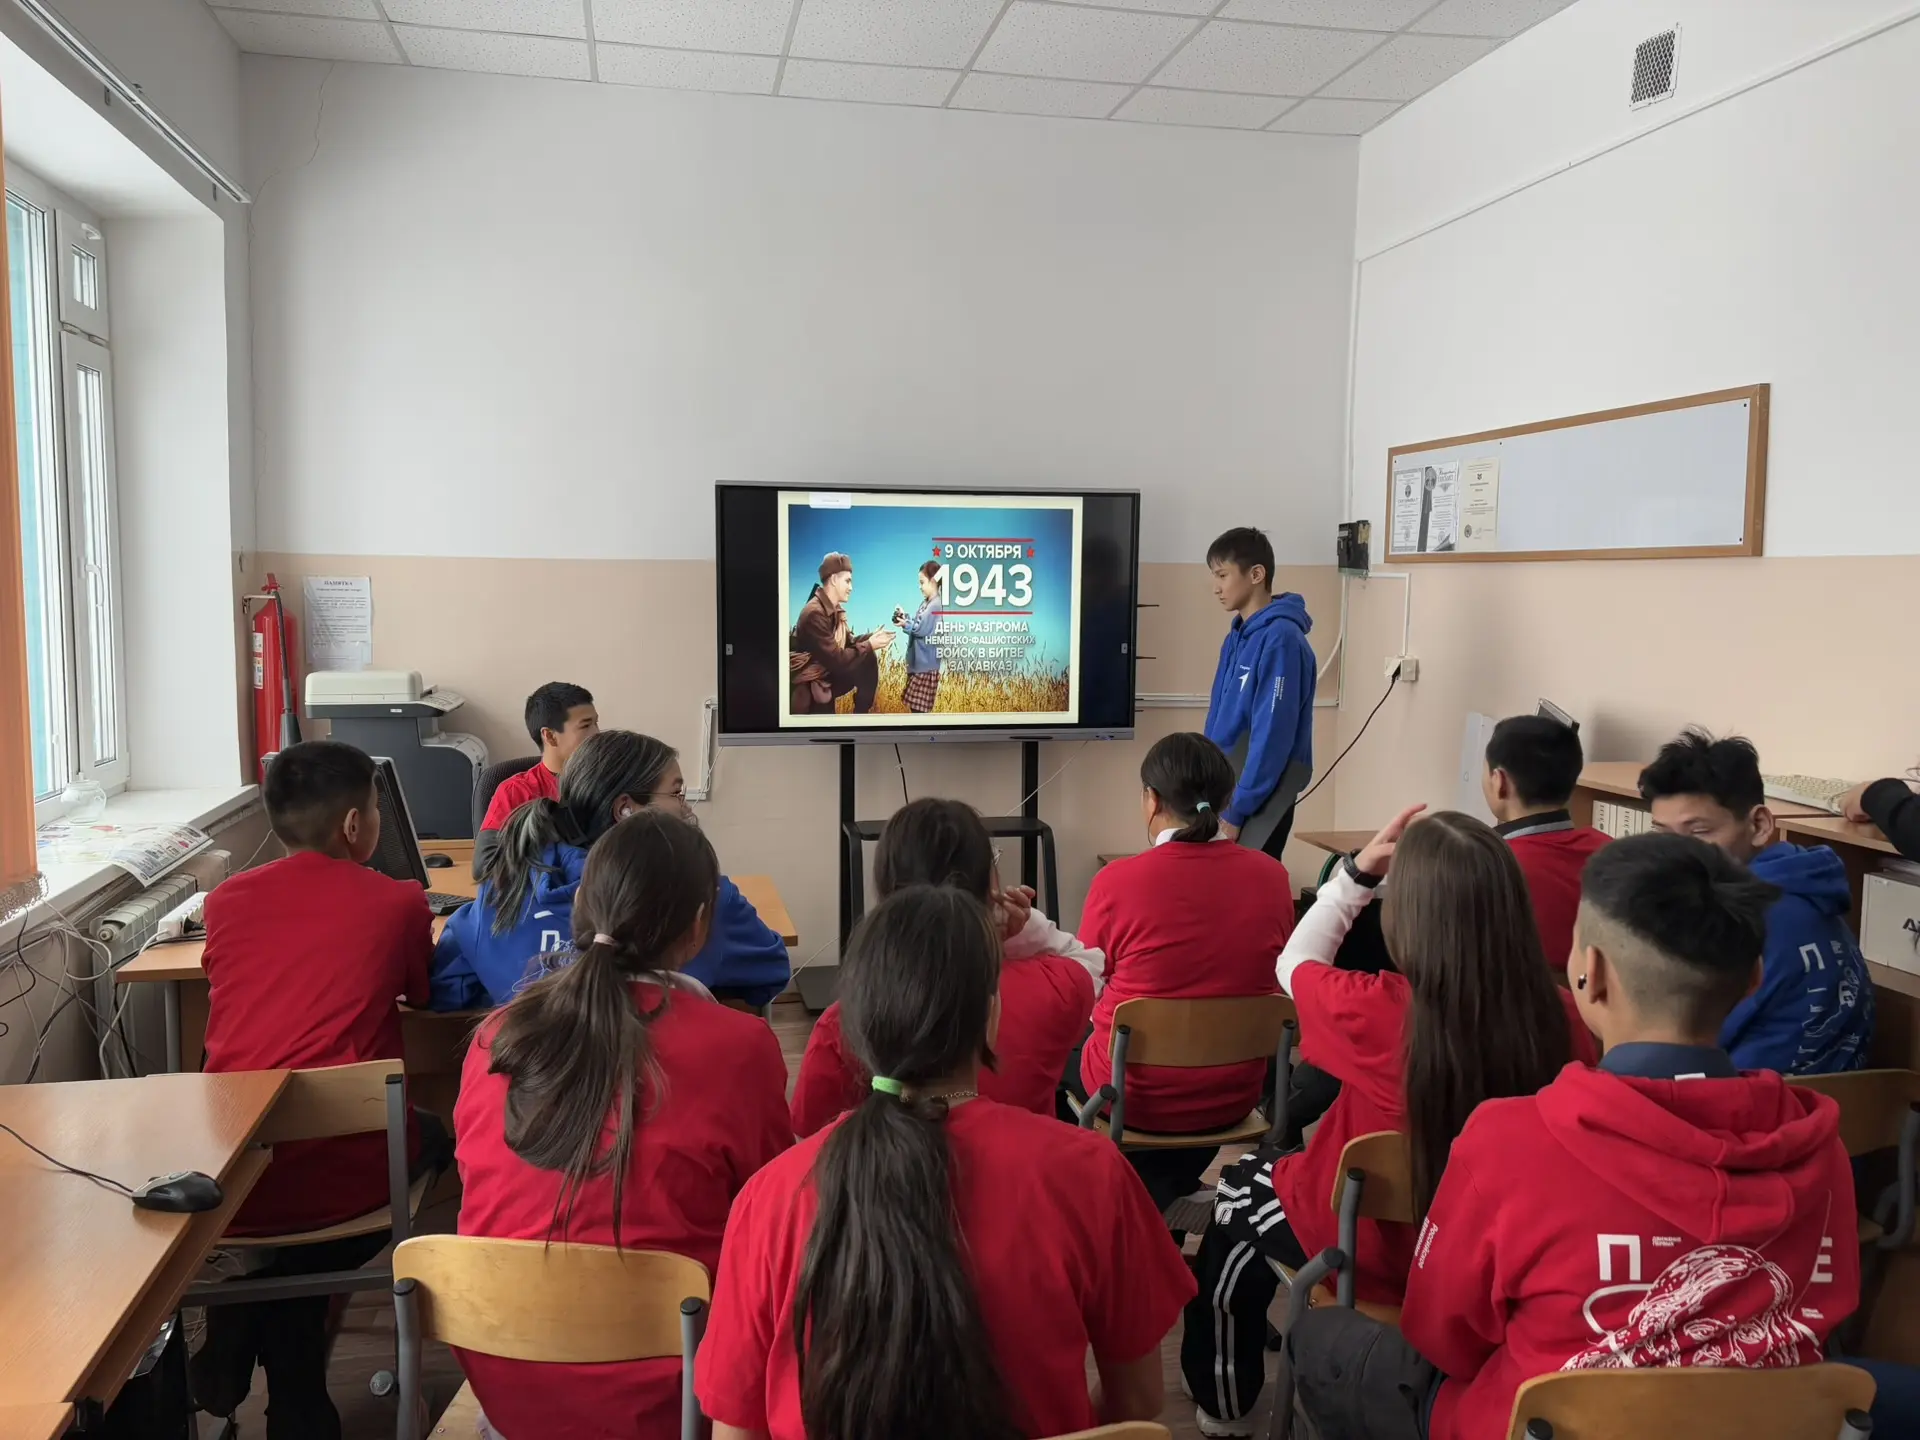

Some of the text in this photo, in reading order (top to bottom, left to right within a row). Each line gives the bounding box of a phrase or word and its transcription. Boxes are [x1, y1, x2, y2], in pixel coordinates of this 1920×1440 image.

[944, 544, 1022, 559] 9 ОКТЯБРЯ
[933, 563, 1033, 607] 1943
[934, 622, 1029, 634] ДЕНЬ РАЗГРОМА
[935, 647, 1025, 659] ВОЙСК В БИТВЕ
[949, 660, 1013, 672] ЗА КАВКАЗ
